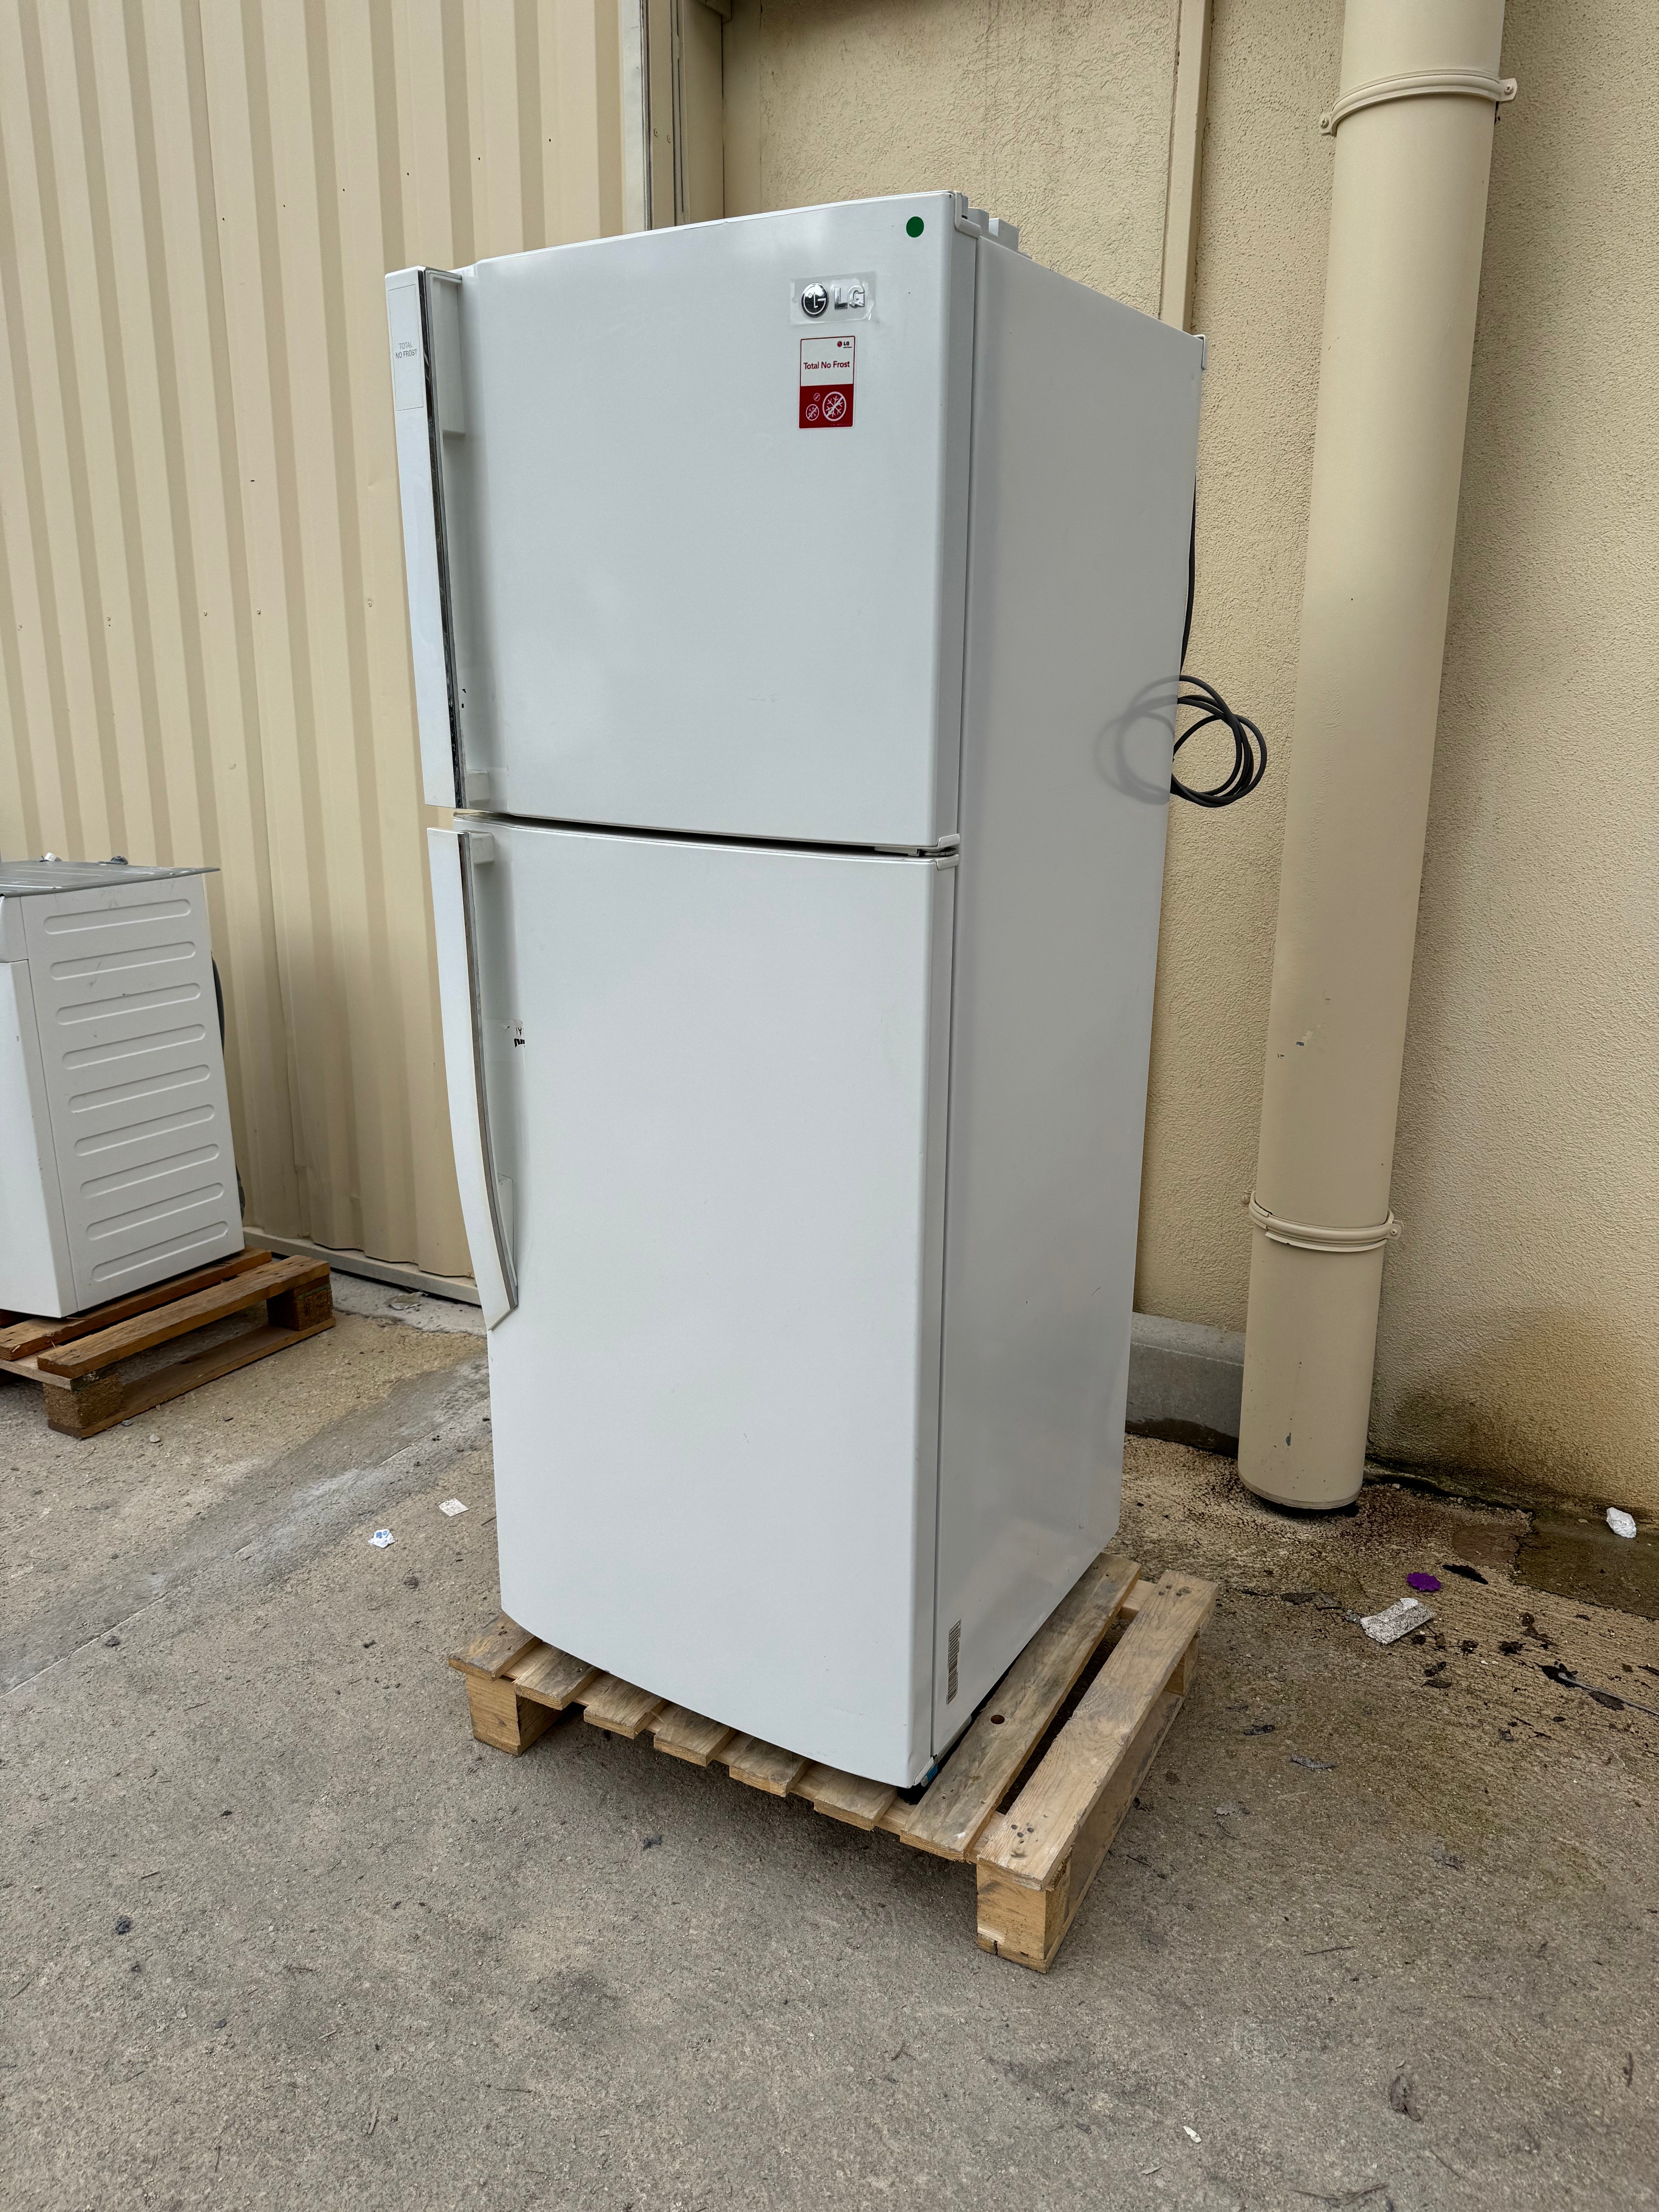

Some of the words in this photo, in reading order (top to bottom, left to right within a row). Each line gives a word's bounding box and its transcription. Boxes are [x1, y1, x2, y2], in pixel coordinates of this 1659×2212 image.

[834, 285, 865, 309] LG
[398, 342, 412, 350] TOTAL
[403, 349, 417, 357] FROST
[803, 361, 819, 369] Total
